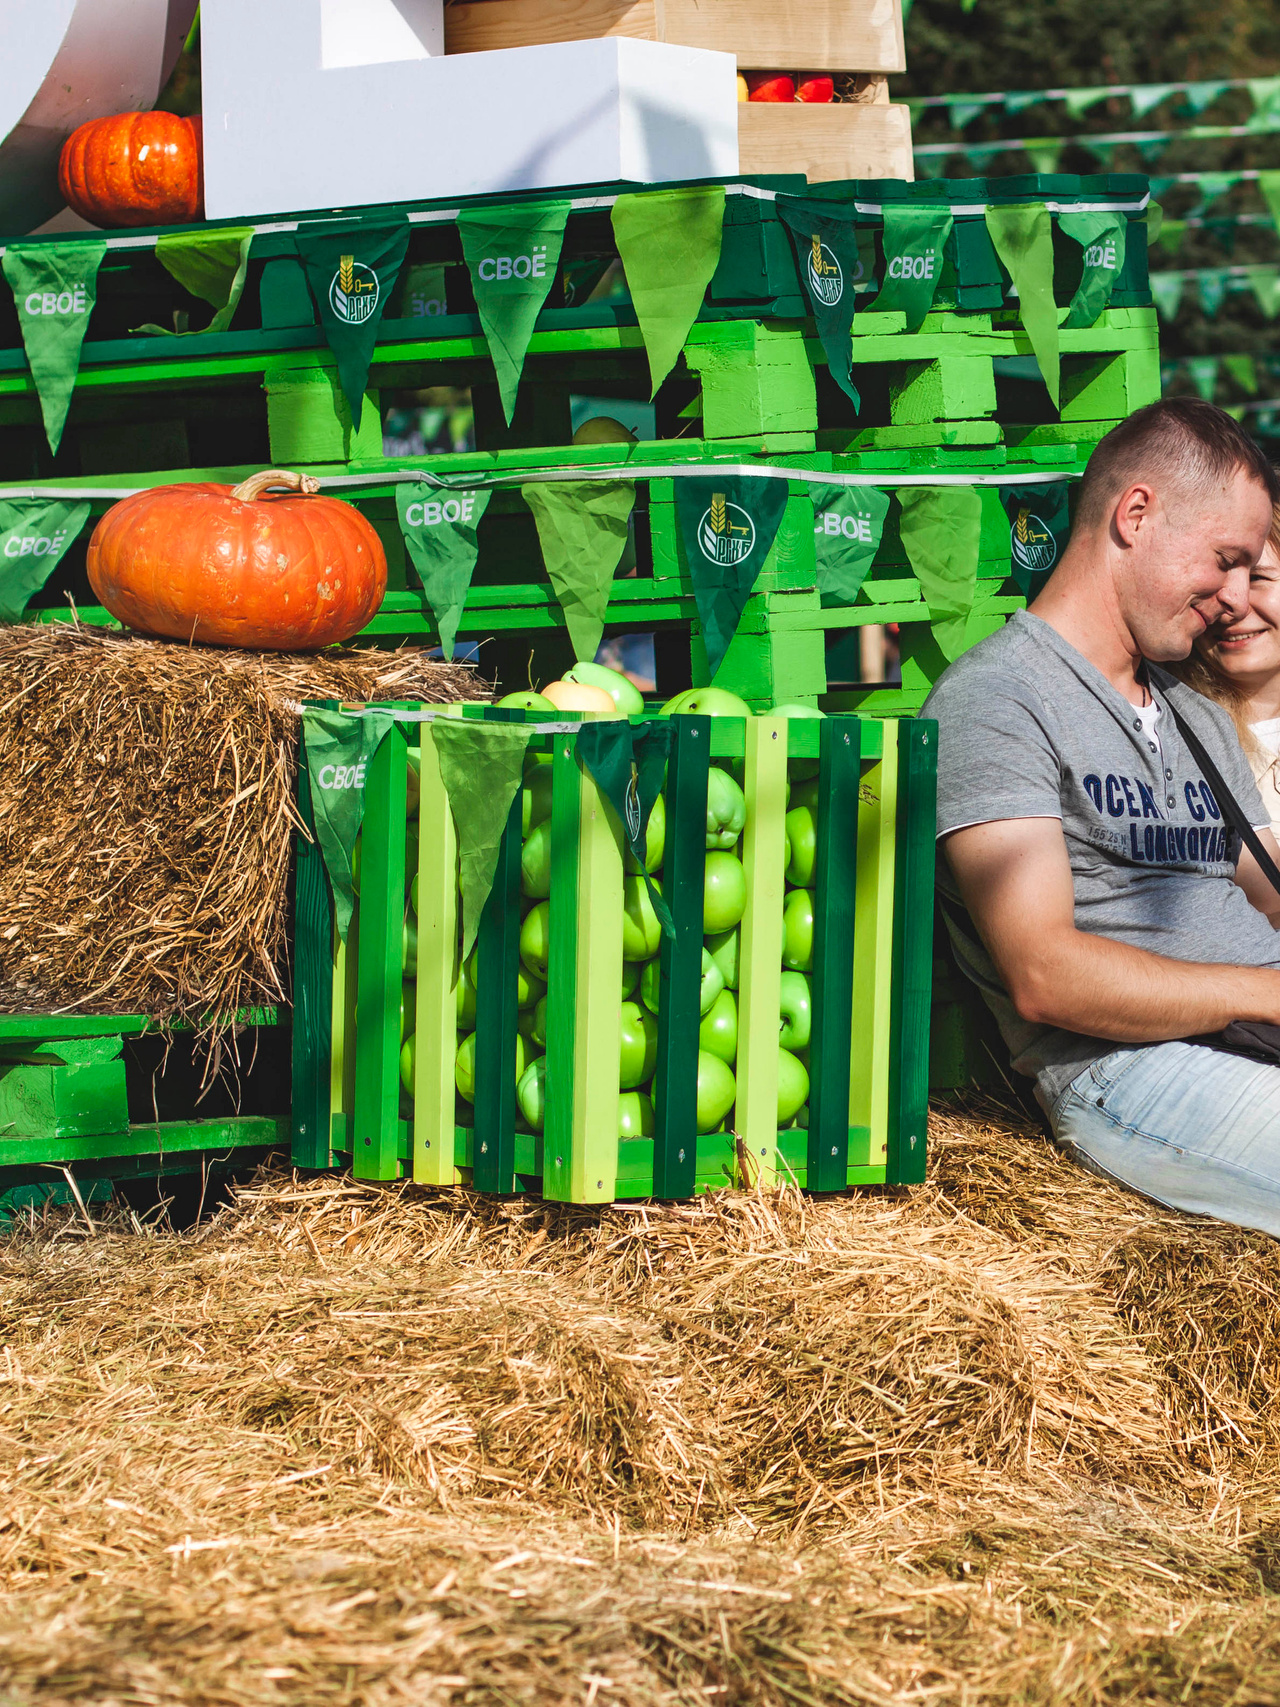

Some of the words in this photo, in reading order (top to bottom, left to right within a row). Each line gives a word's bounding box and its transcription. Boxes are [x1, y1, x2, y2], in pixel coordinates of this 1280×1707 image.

[478, 245, 547, 281] СВОЁ
[888, 248, 935, 280] СВОЁ
[24, 282, 86, 316] СВОЁ
[405, 490, 476, 527] СВОЁ
[3, 528, 68, 558] СВОЁ
[318, 754, 368, 790] СВОЁ
